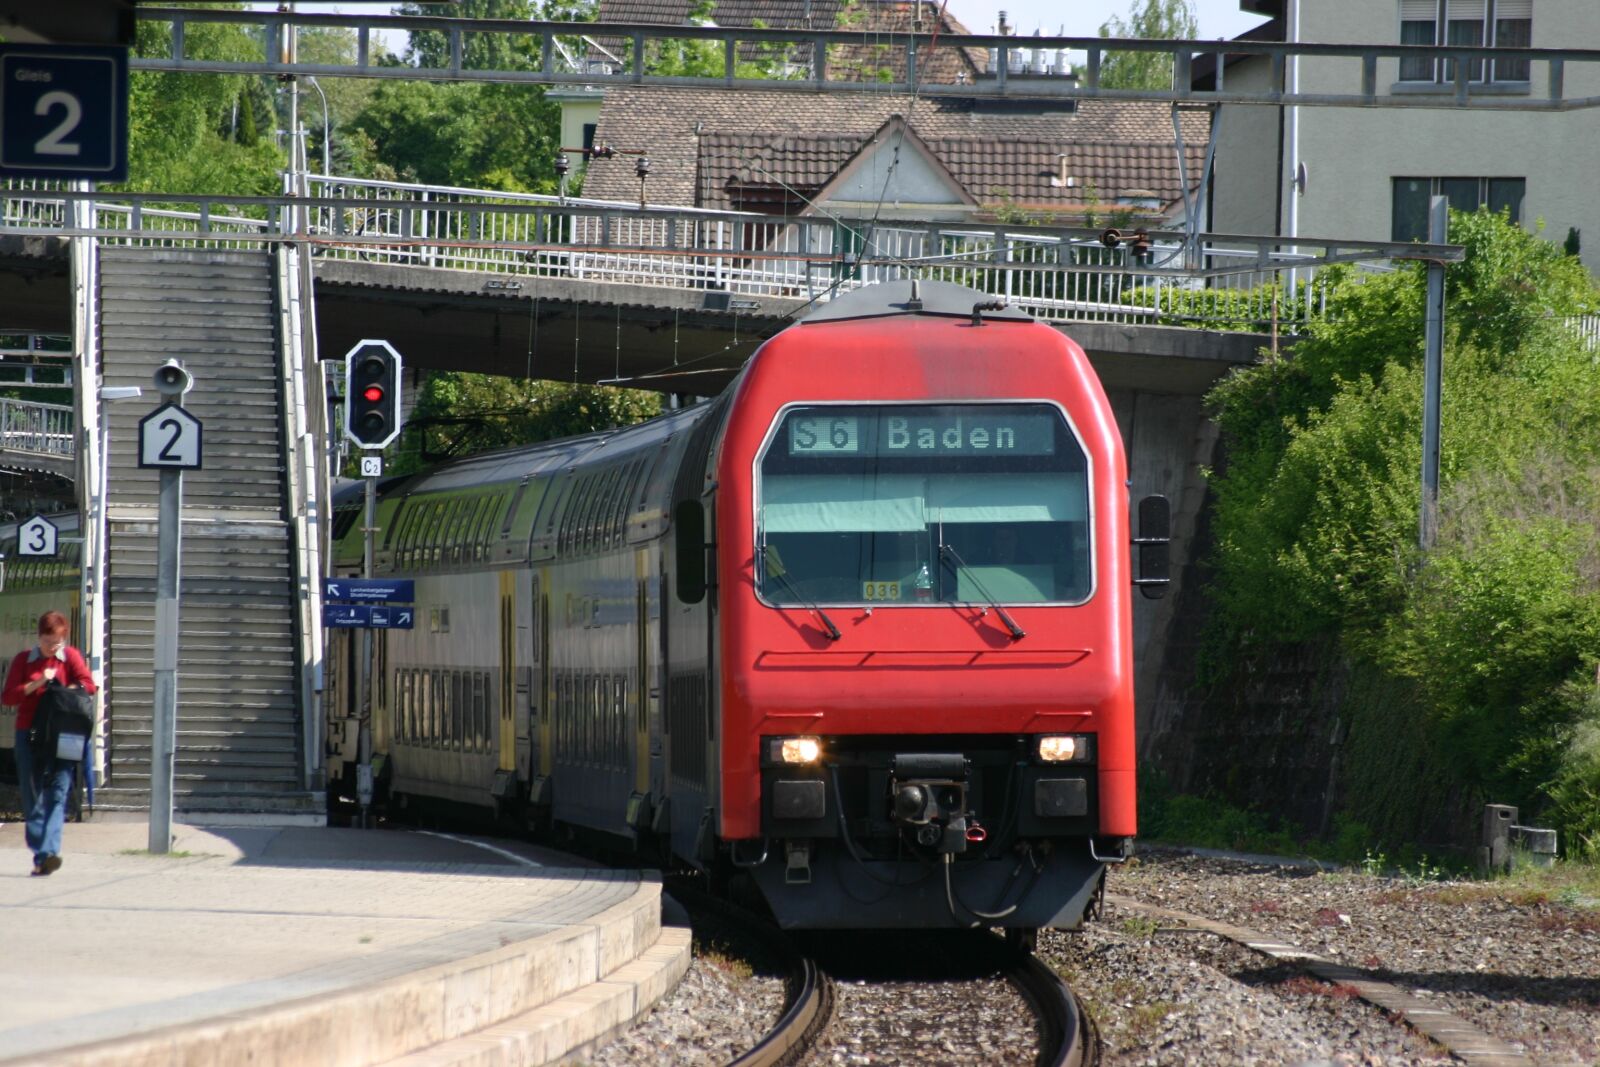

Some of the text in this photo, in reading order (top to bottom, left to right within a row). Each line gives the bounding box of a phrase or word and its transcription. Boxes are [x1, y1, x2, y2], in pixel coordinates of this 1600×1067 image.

[34, 91, 82, 155] 2
[158, 418, 182, 461] 2
[888, 416, 1015, 449] Baden
[28, 523, 46, 552] 3
